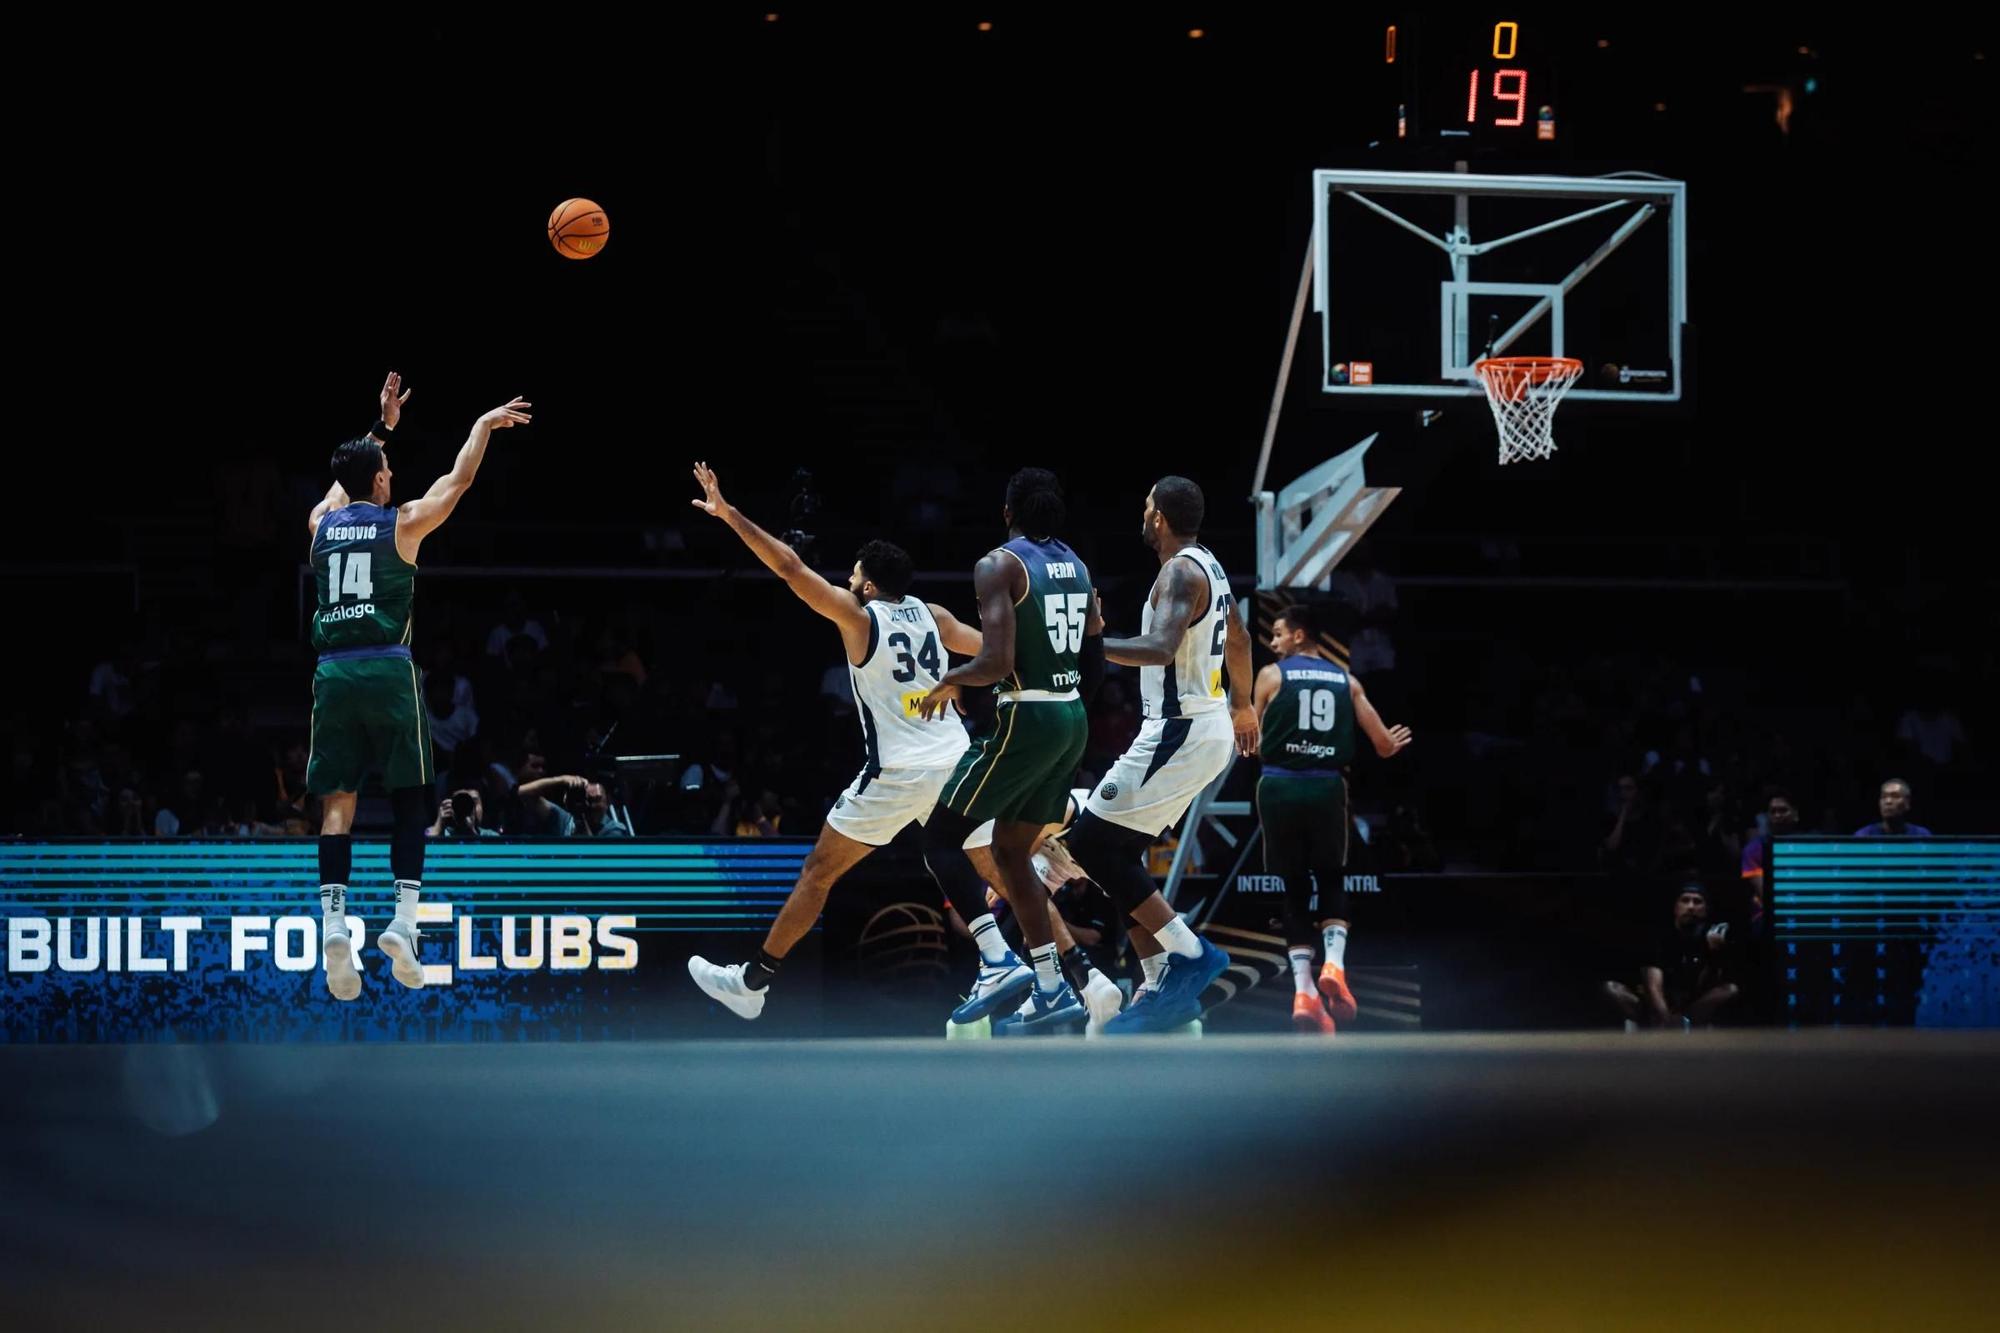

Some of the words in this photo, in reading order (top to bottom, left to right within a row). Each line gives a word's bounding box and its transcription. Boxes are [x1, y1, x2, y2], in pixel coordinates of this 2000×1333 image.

[1492, 21, 1518, 59] 0
[1467, 69, 1527, 126] 19
[328, 552, 373, 604] 14
[1044, 593, 1088, 654] 55
[888, 631, 941, 683] 34
[1298, 689, 1335, 731] 19
[8, 916, 202, 972] BUILT
[231, 916, 365, 971] FOR
